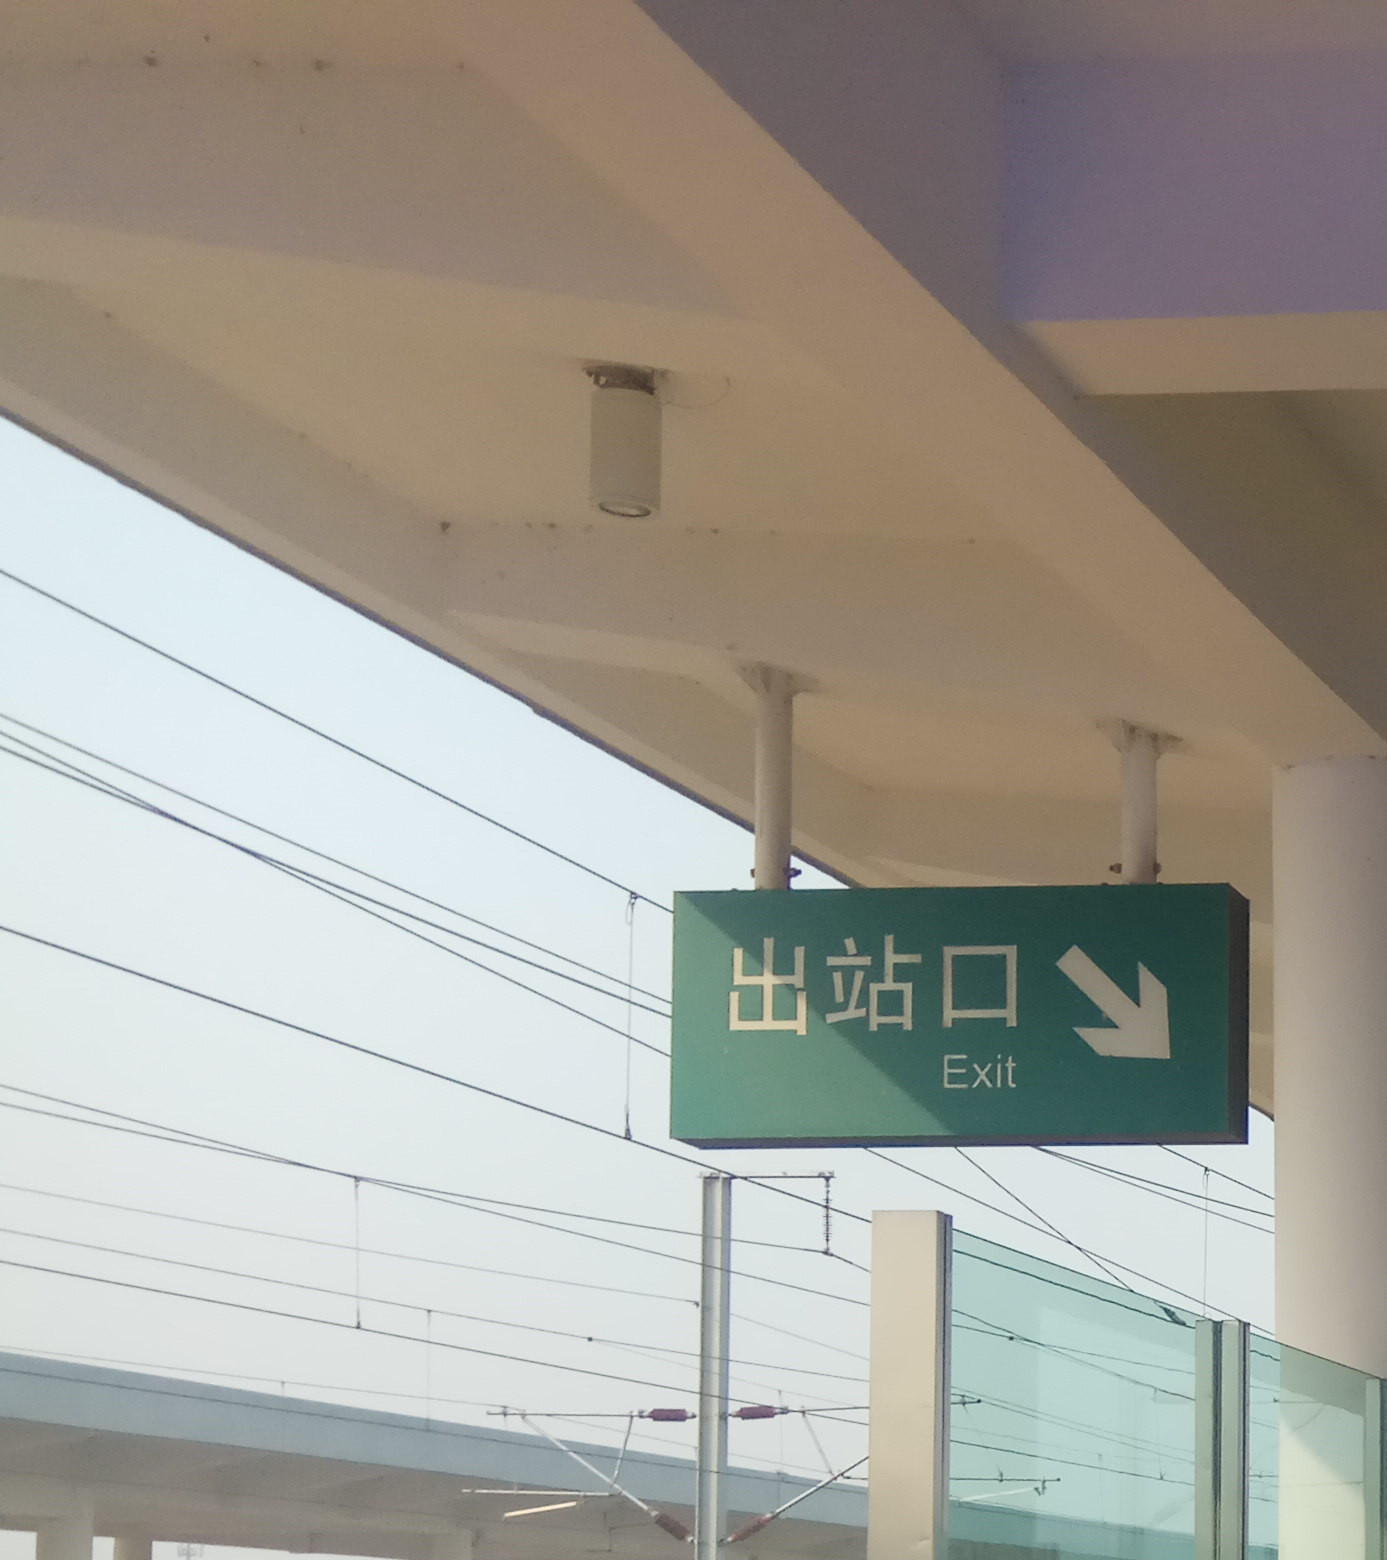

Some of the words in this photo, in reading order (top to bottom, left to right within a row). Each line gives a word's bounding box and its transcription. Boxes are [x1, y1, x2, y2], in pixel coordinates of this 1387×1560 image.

[727, 934, 1018, 1037] 出站口
[941, 1053, 1018, 1090] Exit
